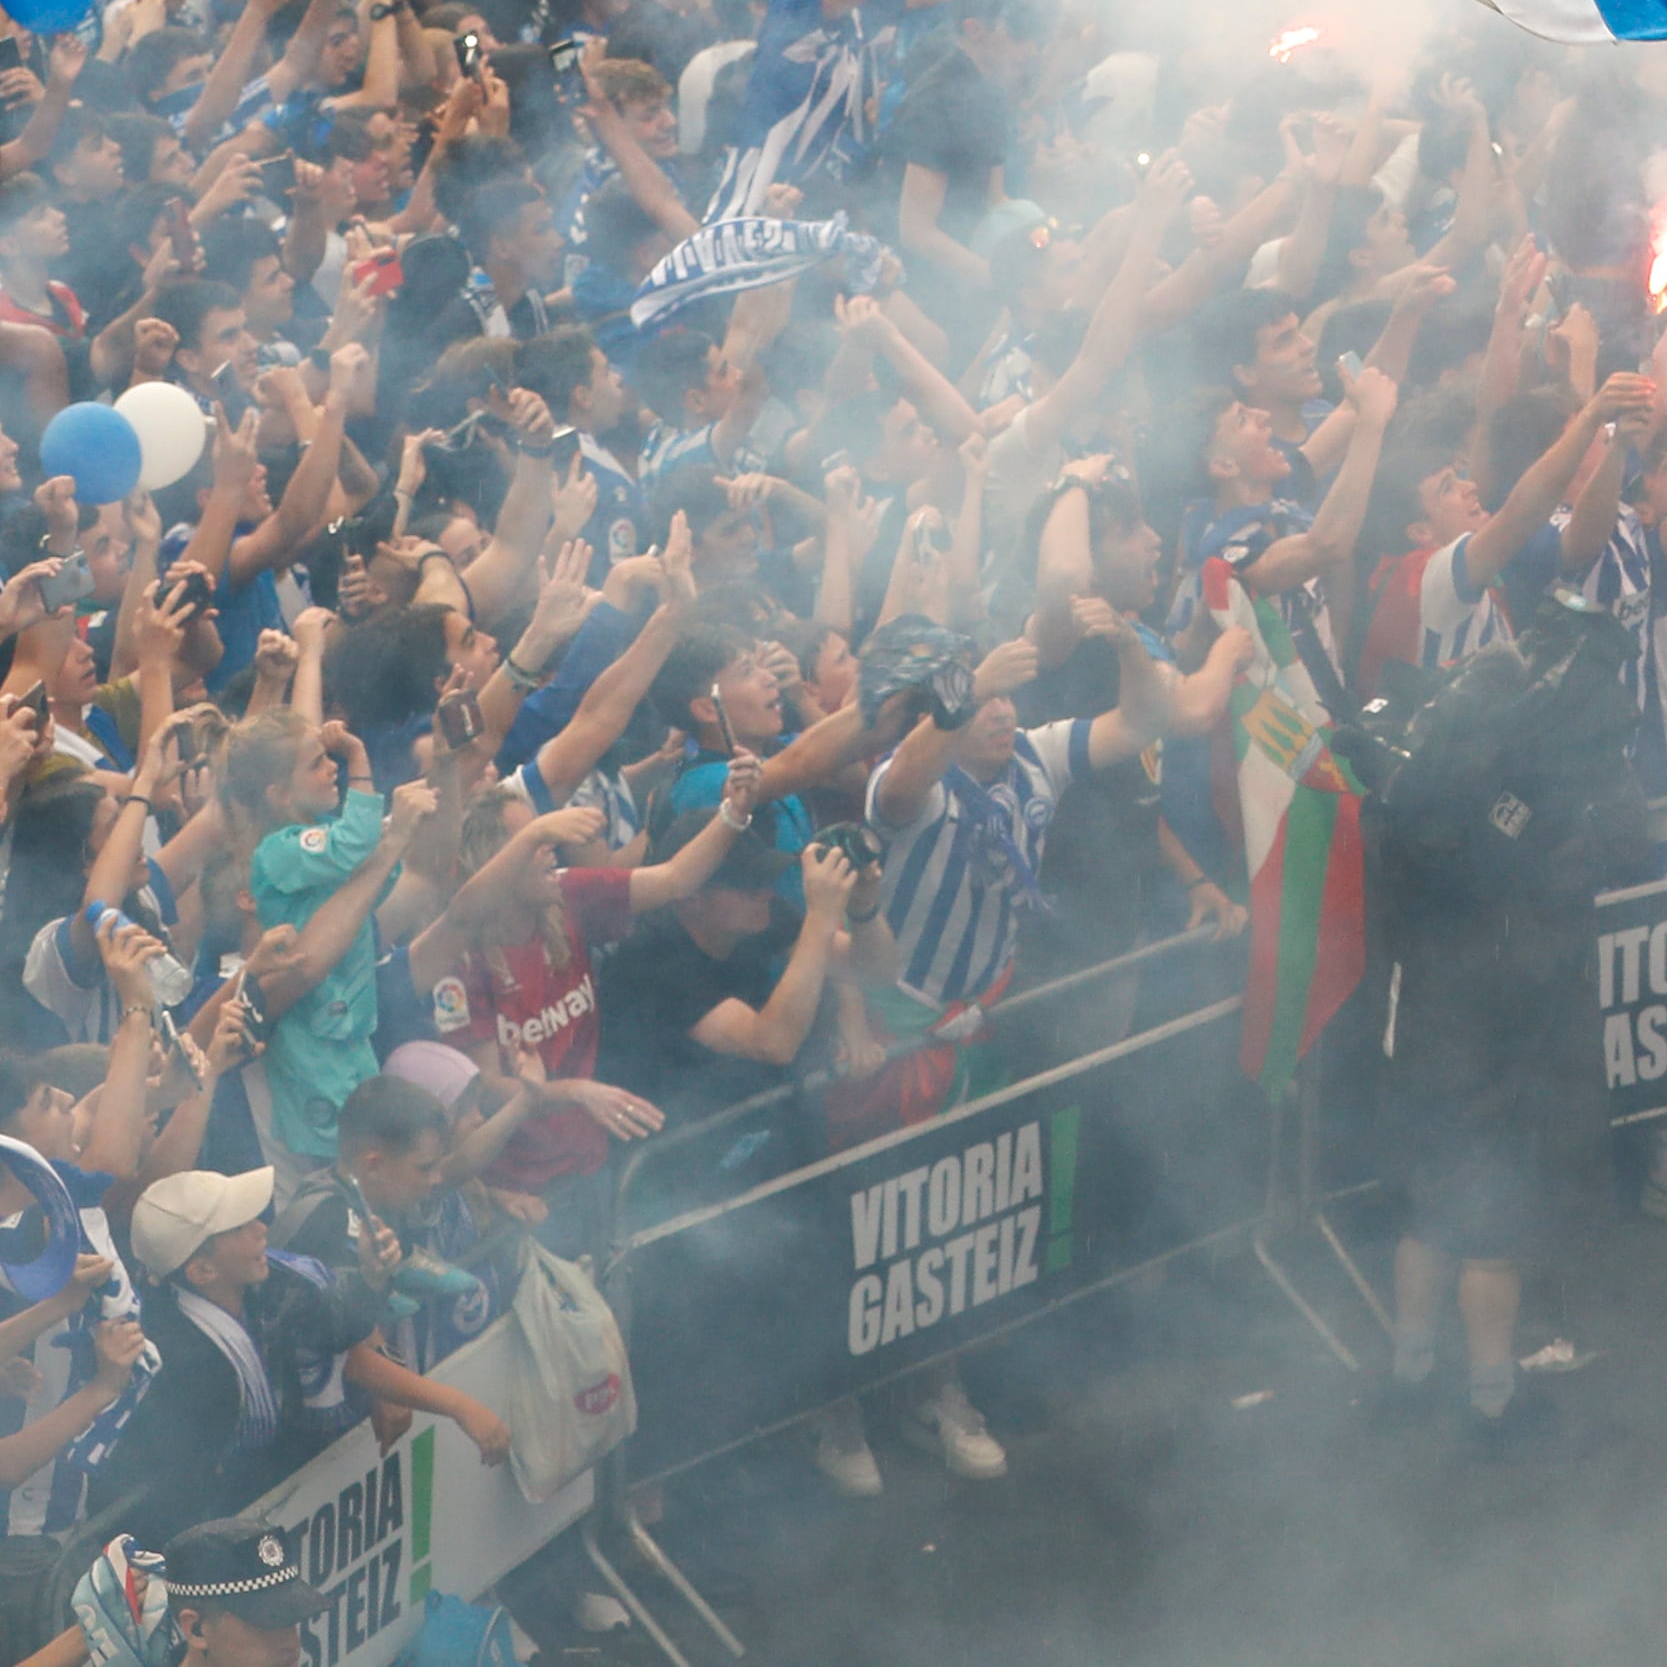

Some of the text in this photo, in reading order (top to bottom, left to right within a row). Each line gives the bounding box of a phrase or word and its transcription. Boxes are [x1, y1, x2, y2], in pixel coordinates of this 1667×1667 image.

[497, 972, 596, 1047] betway
[851, 1120, 1043, 1272] VITORIA
[848, 1204, 1042, 1356] GASTEIZ
[286, 1451, 404, 1588] TORIA
